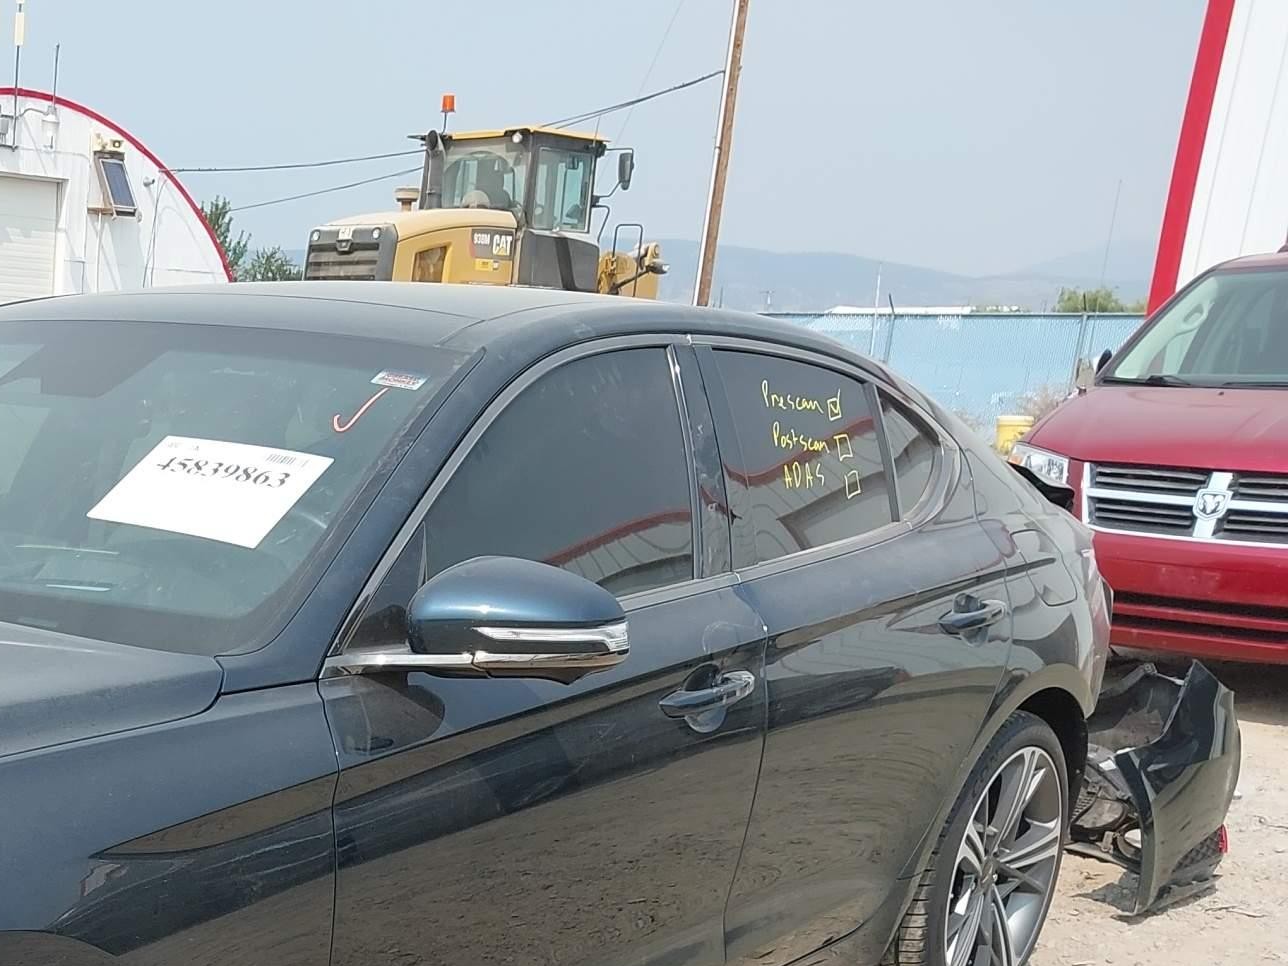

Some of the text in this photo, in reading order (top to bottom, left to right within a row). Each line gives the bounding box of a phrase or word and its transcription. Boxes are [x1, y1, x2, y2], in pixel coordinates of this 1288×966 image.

[493, 234, 513, 256] CAT
[761, 379, 824, 414] Prescan
[156, 456, 290, 488] 45839863
[783, 461, 825, 489] ADAS
